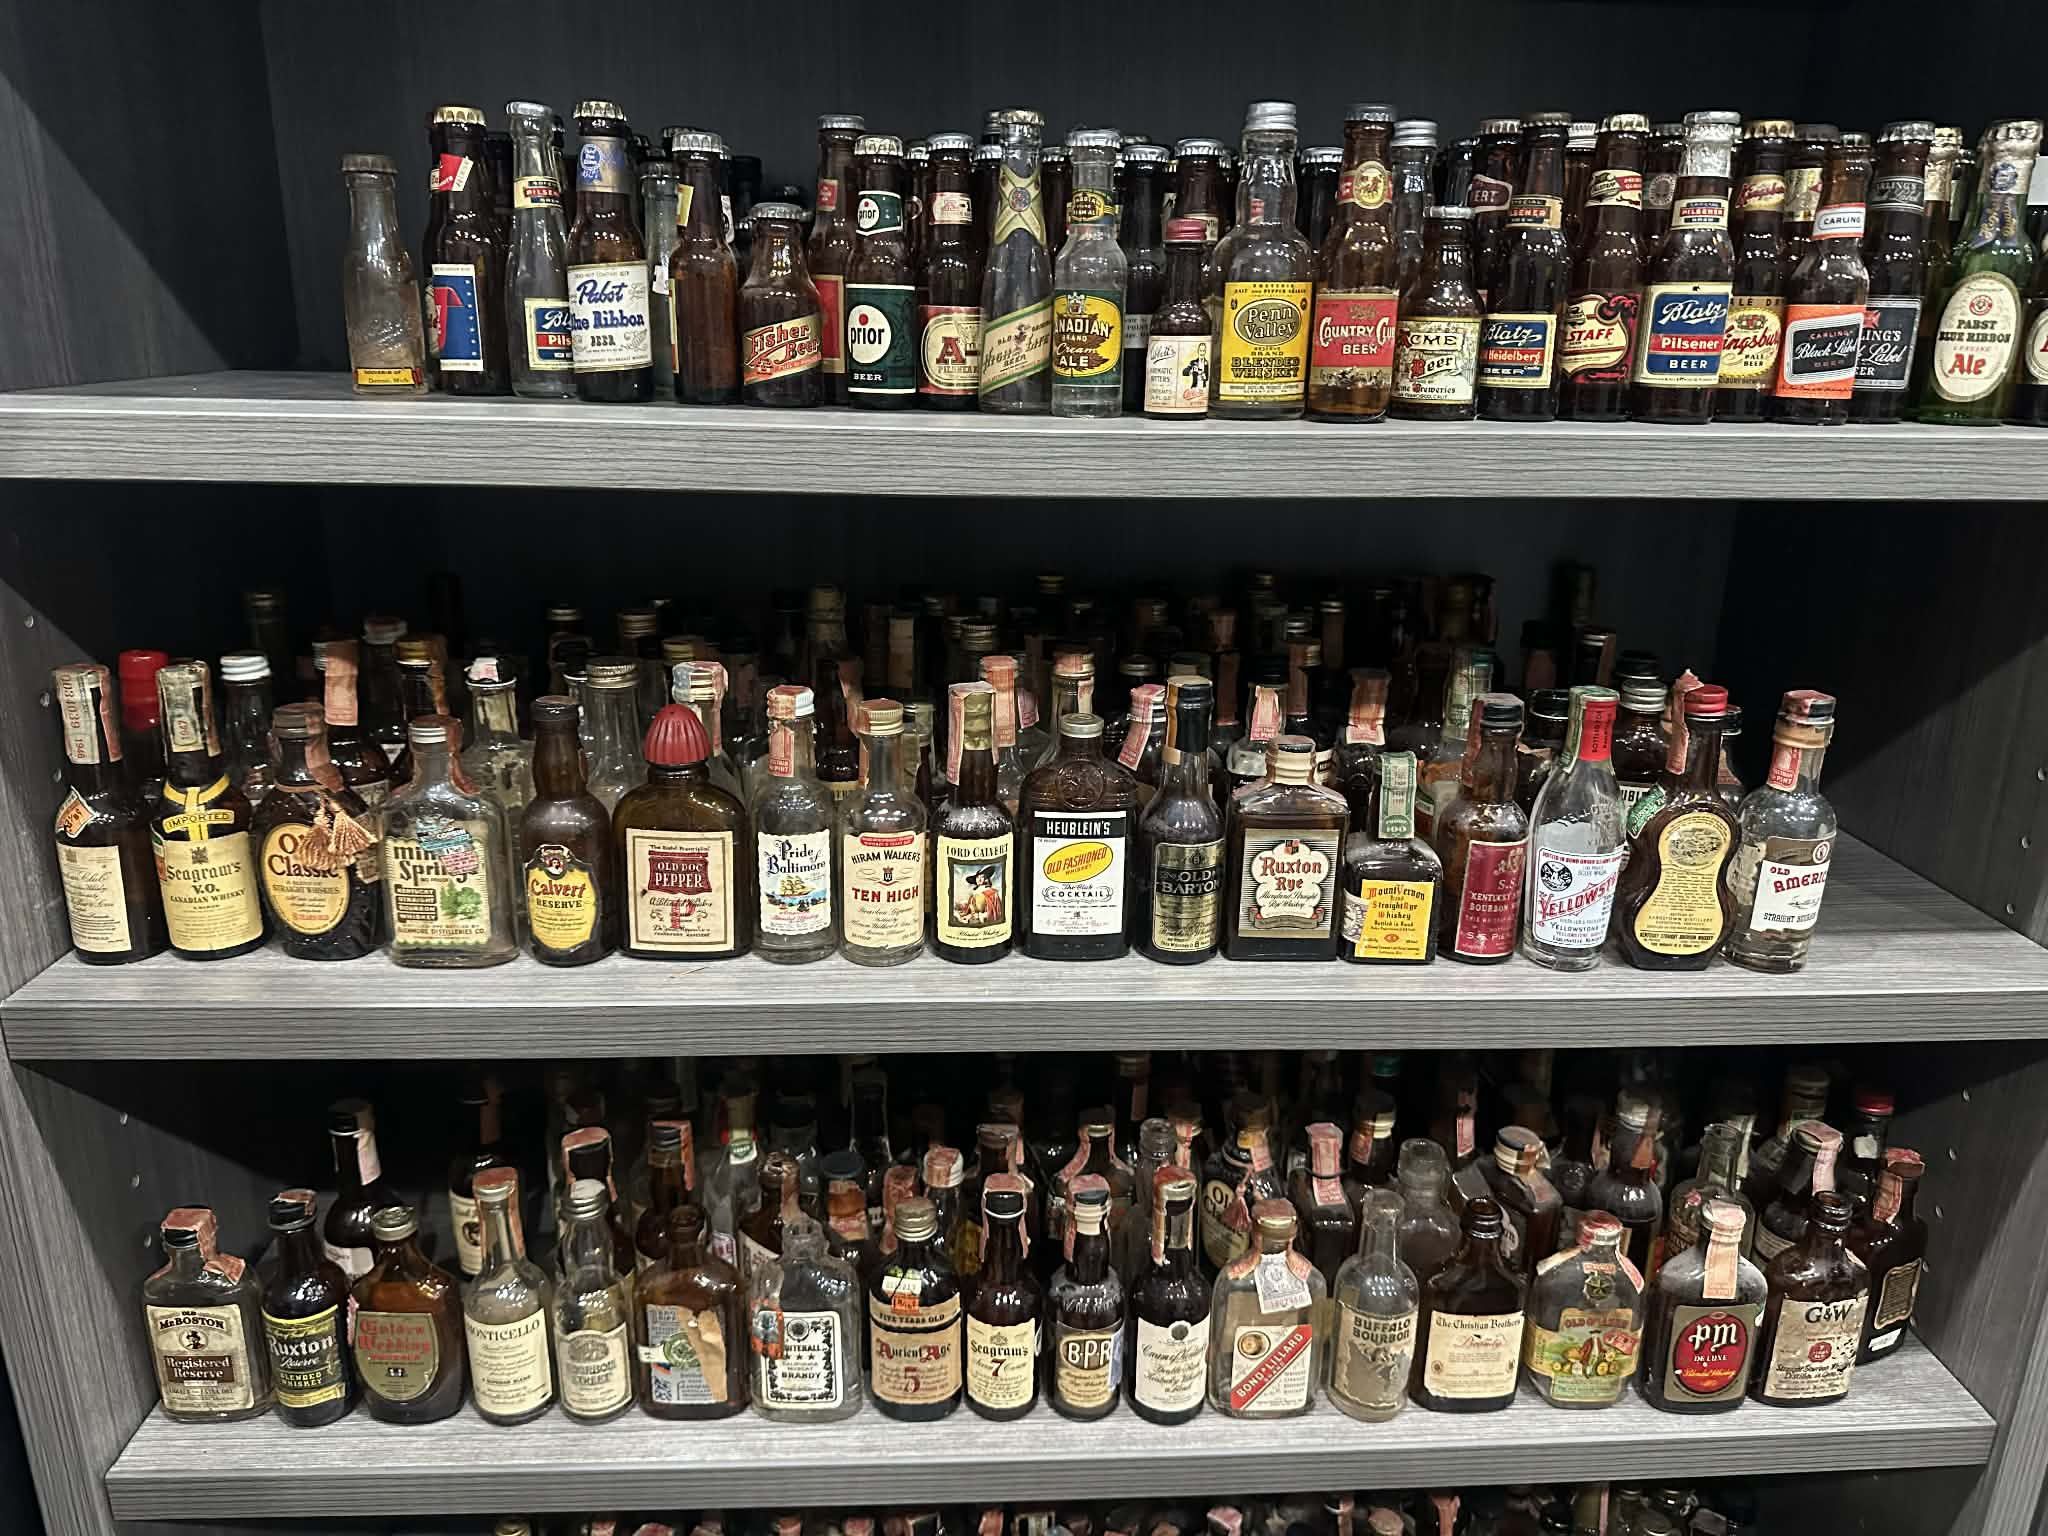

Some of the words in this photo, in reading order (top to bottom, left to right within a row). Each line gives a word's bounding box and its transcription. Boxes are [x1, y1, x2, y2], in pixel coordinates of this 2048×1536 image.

[858, 208, 877, 220] prior
[1823, 216, 1861, 225] CARLING
[576, 279, 628, 306] Pabst
[570, 314, 590, 331] lue
[592, 310, 645, 330] Ribbon
[1247, 306, 1293, 323] Penn
[1658, 300, 1727, 325] Blatz
[1243, 321, 1296, 339] Valley
[1319, 316, 1376, 347] COUNTRY
[1956, 319, 1998, 330] PABST
[590, 335, 616, 347] BEER
[749, 323, 810, 358] Fisher
[850, 326, 885, 350] prior
[1486, 322, 1542, 346] Blatz
[1568, 328, 1615, 342] STAFF
[1965, 332, 2011, 344] RIBBON
[774, 338, 820, 365] Beer
[1056, 343, 1098, 355] Cream
[1342, 343, 1378, 355] BEER
[1661, 337, 1720, 350] Pilsener
[1793, 342, 1833, 360] Black
[1059, 355, 1089, 367] ALE
[1231, 356, 1300, 367] BLENDED
[1488, 347, 1541, 366] Heidelberg
[1863, 342, 1907, 365] Label
[1231, 367, 1300, 378] WHISKEY
[1409, 354, 1453, 379] Beer
[1482, 367, 1524, 375] BEER
[1669, 360, 1708, 369] BEER
[1948, 353, 1987, 376] Ale
[853, 373, 883, 382] BEER
[168, 811, 230, 828] IMPORTED
[1046, 821, 1112, 836] HEUBLEIN'S
[1386, 825, 1408, 833] 100
[779, 839, 814, 861] Pride
[851, 852, 881, 865] HIRAM
[883, 850, 921, 863] WALKER'S
[946, 846, 971, 858] LORD
[973, 843, 1009, 858] CALVERT
[657, 861, 679, 871] OLD
[681, 863, 703, 872] DOC
[765, 854, 826, 875] Baltimore
[1047, 860, 1063, 875] OLD
[1062, 847, 1108, 871] FASHIONED
[1259, 856, 1322, 877] Ruxton
[166, 861, 241, 883] Seagram's
[1180, 870, 1212, 882] OLD
[1769, 866, 1790, 876] OLD
[655, 872, 704, 888] PEPPER
[1161, 879, 1218, 895] BARTON
[1273, 876, 1304, 892] Rye
[1773, 871, 1828, 893] AMERIC
[170, 895, 209, 905] CANADIAN
[211, 888, 246, 902] WHISKY
[192, 883, 221, 894] V.O.
[530, 879, 587, 899] Calvert
[852, 887, 881, 903] TEN
[886, 885, 919, 903] HIGH
[1051, 890, 1103, 898] COCKTAIL
[1364, 886, 1397, 900] Mount
[1396, 885, 1425, 901] Vernon
[1539, 871, 1617, 919] YELLOWST
[536, 898, 583, 909] RESERVE
[1372, 901, 1403, 911] Straight
[1403, 901, 1419, 911] Rye
[1469, 902, 1508, 912] BOURBON
[1378, 911, 1412, 921] Whiskey
[1763, 911, 1795, 923] STRAIGHT
[928, 1314, 945, 1323] OLD
[1804, 1303, 1853, 1324] G&W
[174, 1316, 225, 1330] BOSTON
[467, 1319, 540, 1341] MONTICELLO
[1353, 1316, 1411, 1332] BUFFALO
[1435, 1316, 1451, 1328] The
[1452, 1318, 1489, 1330] Christian
[1490, 1317, 1521, 1329] Brothers
[1352, 1326, 1410, 1344] BOURBON
[1688, 1323, 1738, 1352] pm
[266, 1335, 333, 1356] Ruxton
[876, 1339, 922, 1360] Ancient
[920, 1343, 951, 1361] Age
[970, 1339, 1029, 1357] Seagram's
[164, 1355, 231, 1370] Registered
[1235, 1371, 1266, 1397] BOND
[1265, 1332, 1304, 1371] LILLARD
[1693, 1354, 1705, 1362] DE
[174, 1368, 224, 1378] Reserve
[990, 1358, 1007, 1377] 7
[280, 1371, 322, 1381] BLENDED
[903, 1366, 921, 1393] 5
